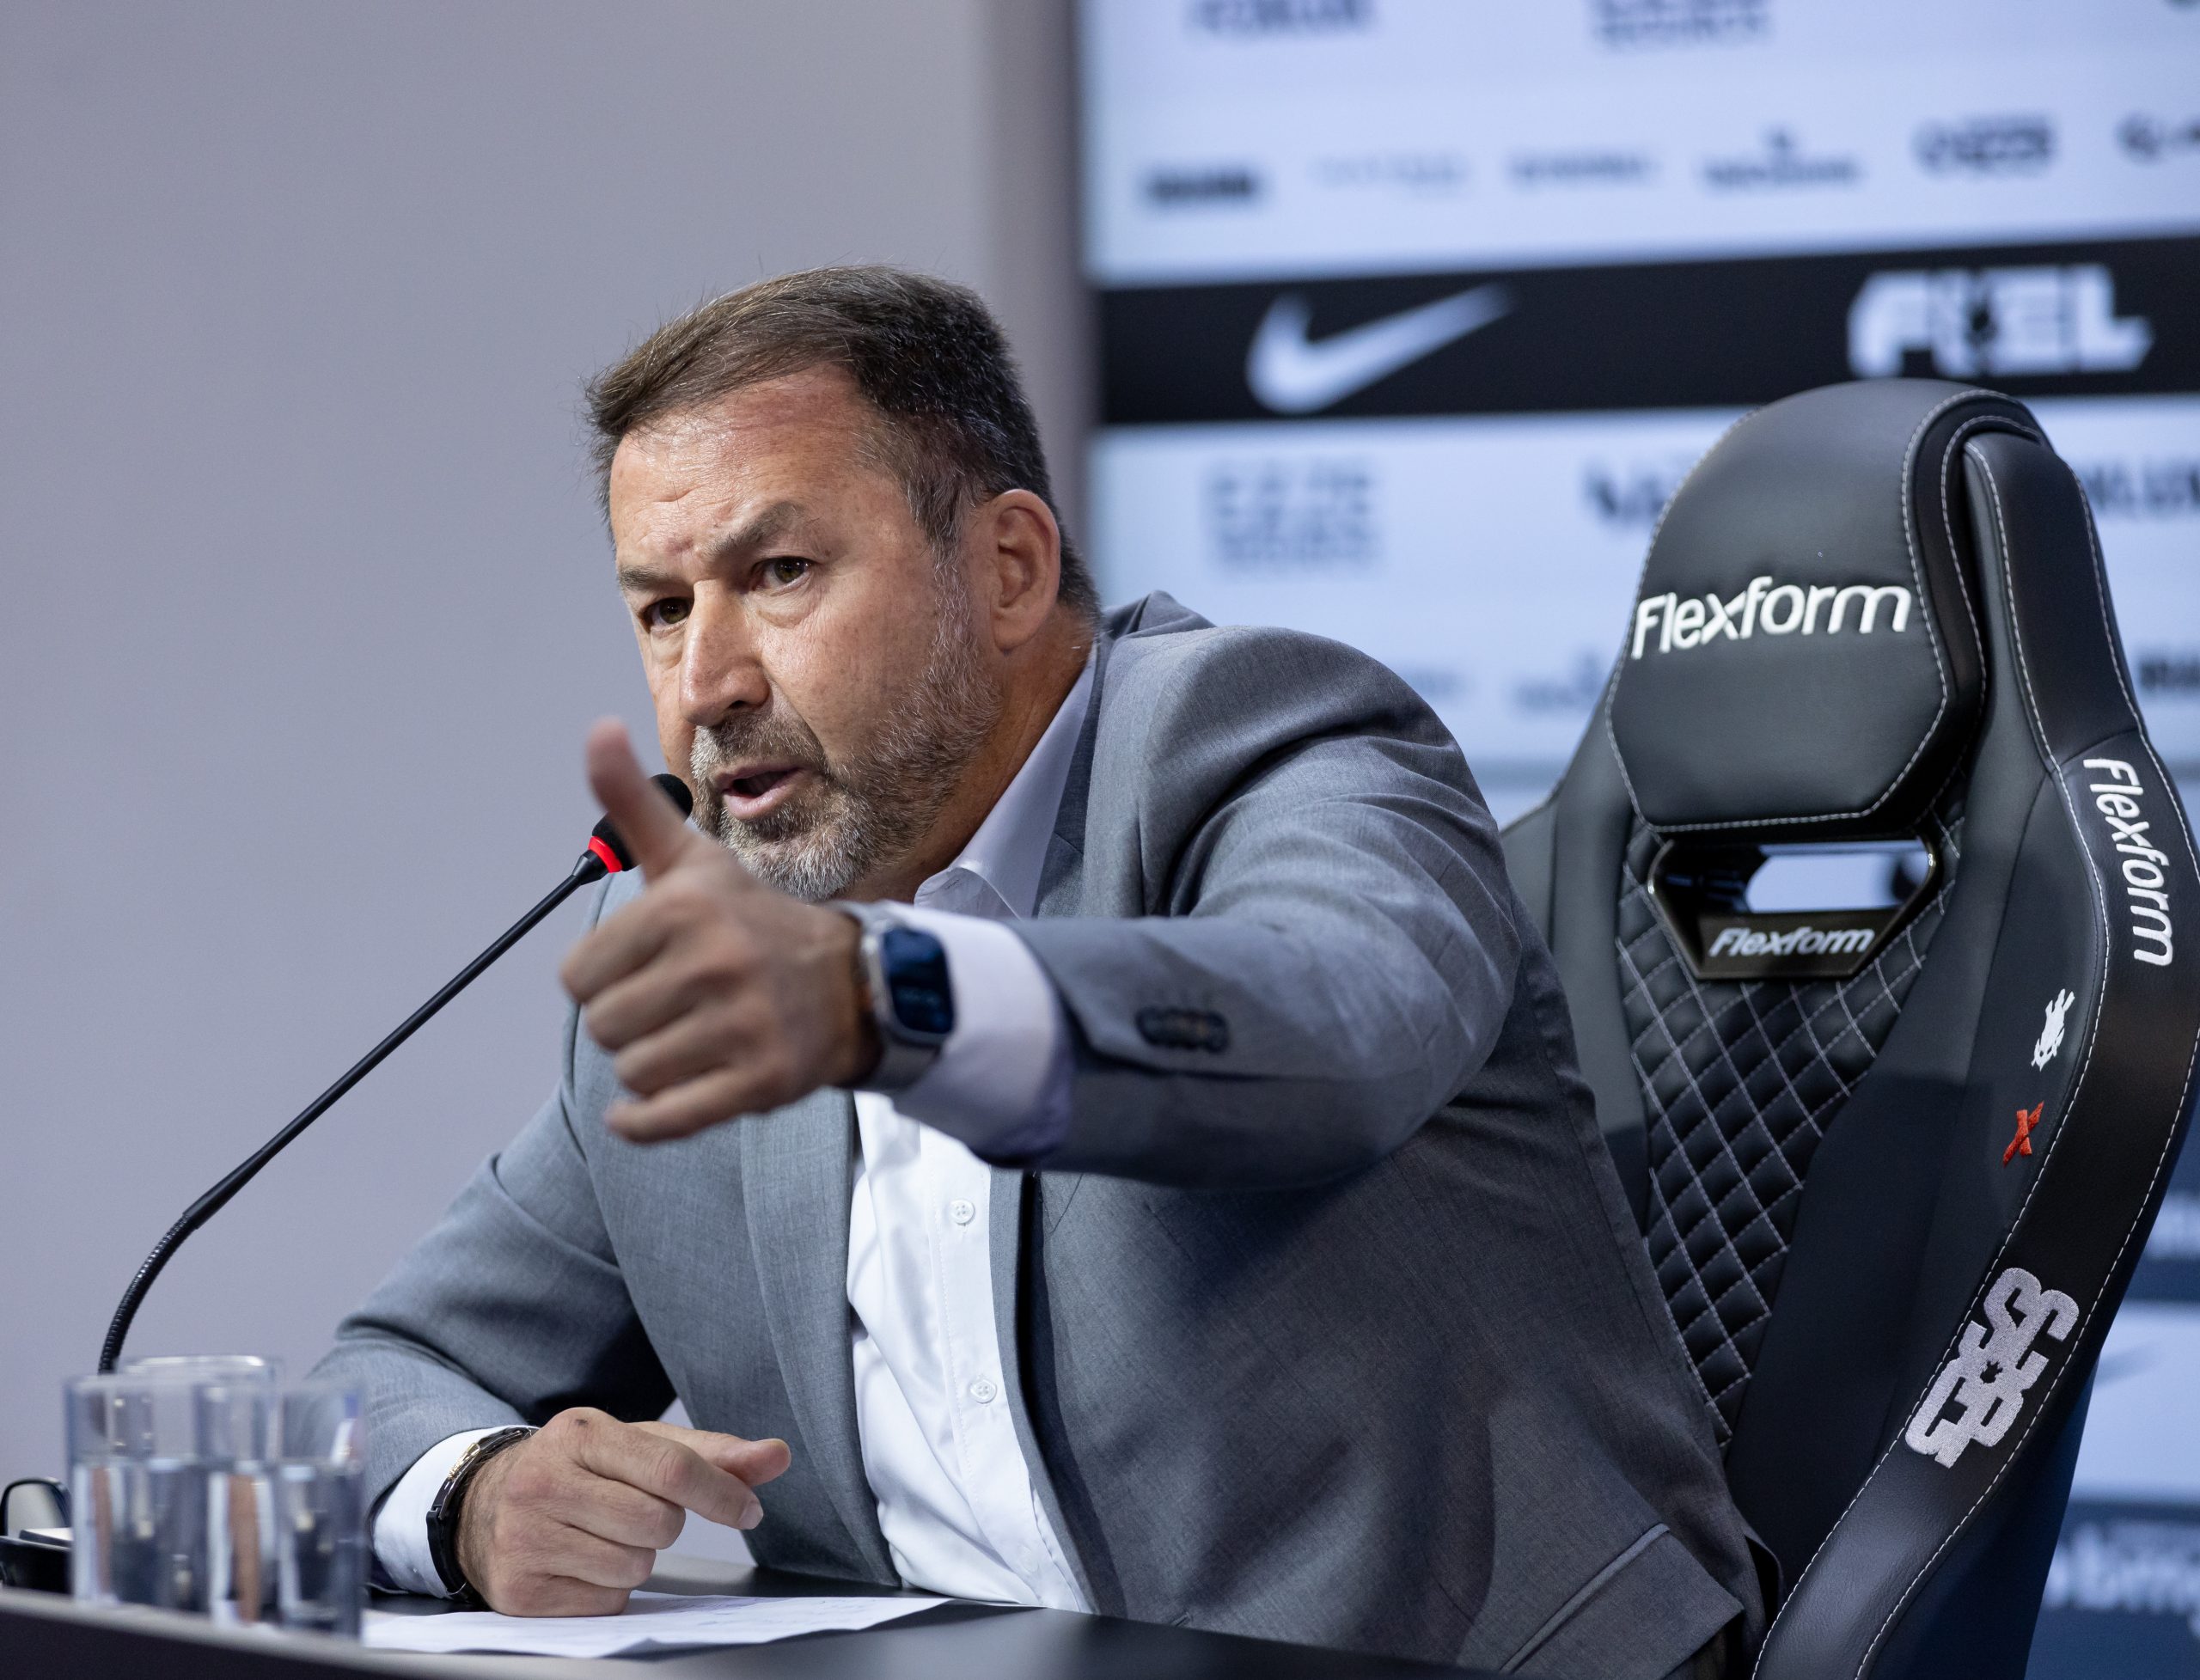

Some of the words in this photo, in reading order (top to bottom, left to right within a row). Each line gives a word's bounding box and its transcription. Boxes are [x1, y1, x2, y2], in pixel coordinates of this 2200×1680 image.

[1631, 576, 1912, 660] Flexform
[2082, 758, 2175, 966] Flexform
[1708, 926, 1875, 956] Flexform
